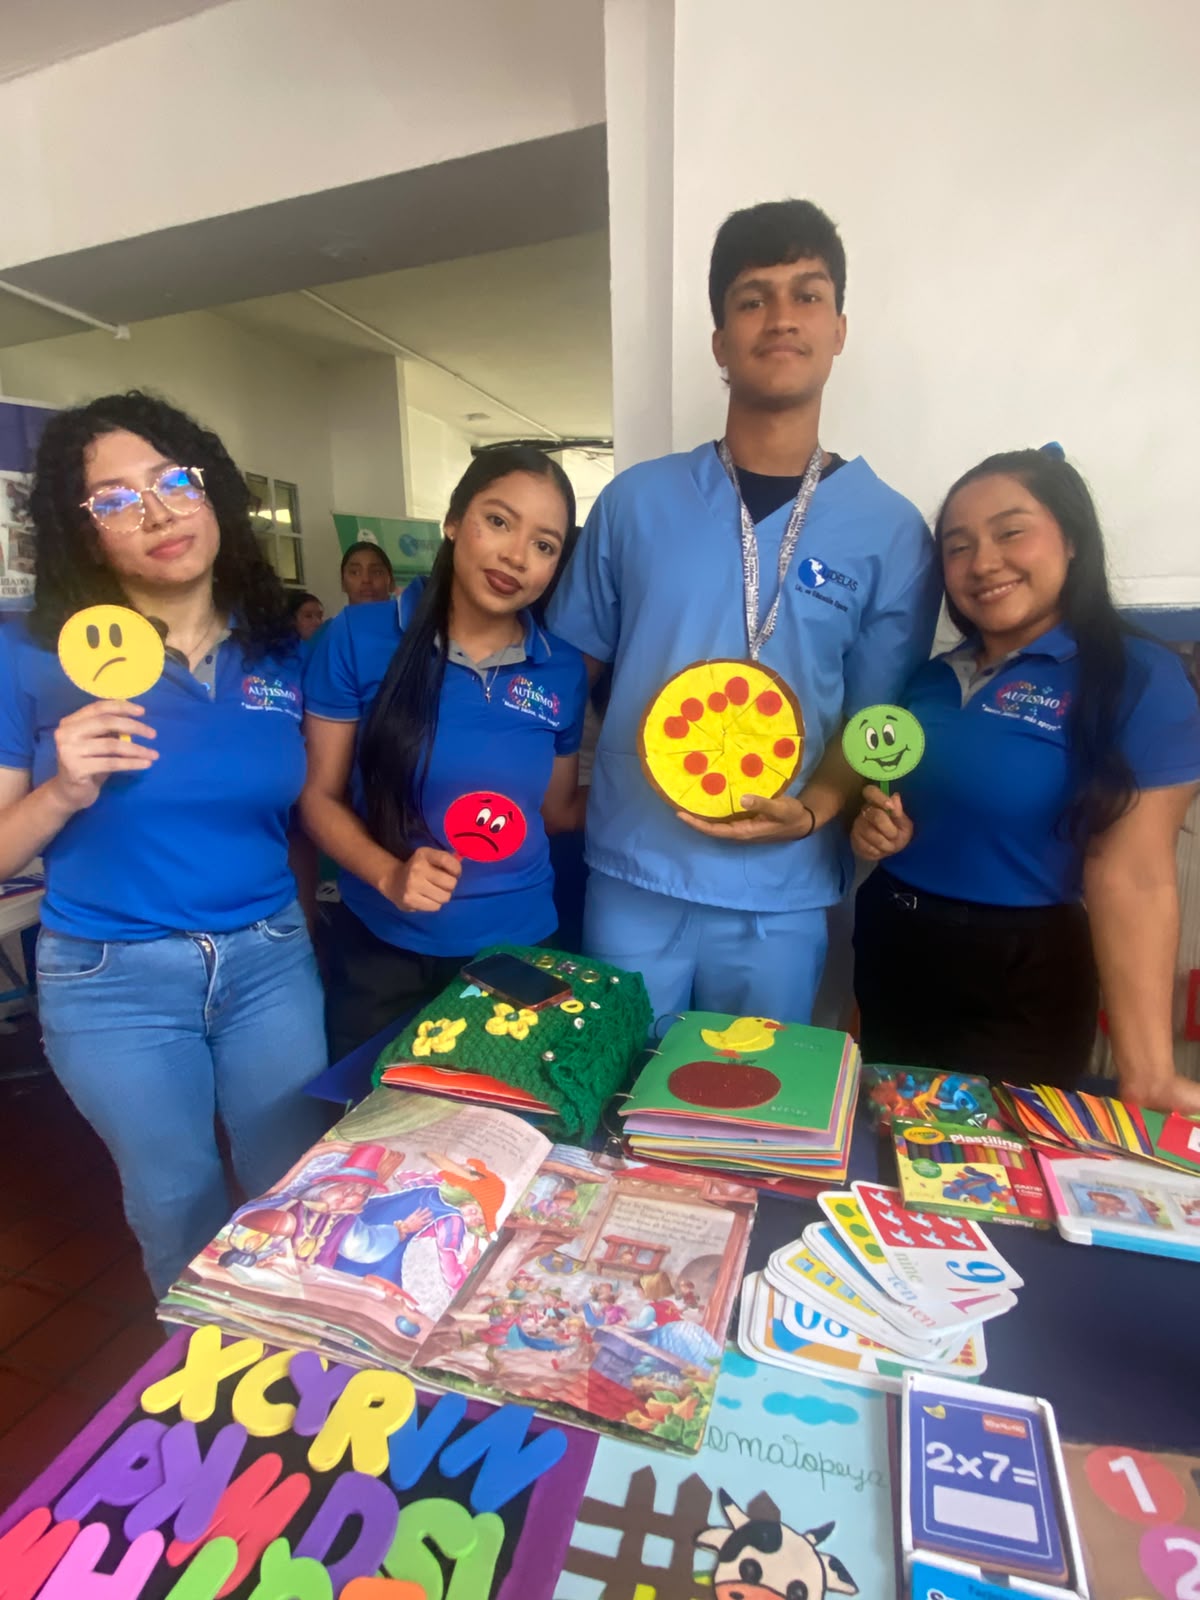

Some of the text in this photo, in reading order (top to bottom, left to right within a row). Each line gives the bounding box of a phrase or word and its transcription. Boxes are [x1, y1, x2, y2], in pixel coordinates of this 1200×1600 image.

[248, 686, 296, 702] AUTISMO
[511, 685, 553, 710] AUTISMO
[1001, 690, 1060, 710] AUTISMO
[949, 1133, 1023, 1151] Plastilina
[893, 1251, 923, 1284] nine
[945, 1260, 1006, 1284] 9
[925, 1440, 1038, 1487] 2x7=
[1108, 1455, 1158, 1514] 1
[1163, 1537, 1200, 1600] 2
